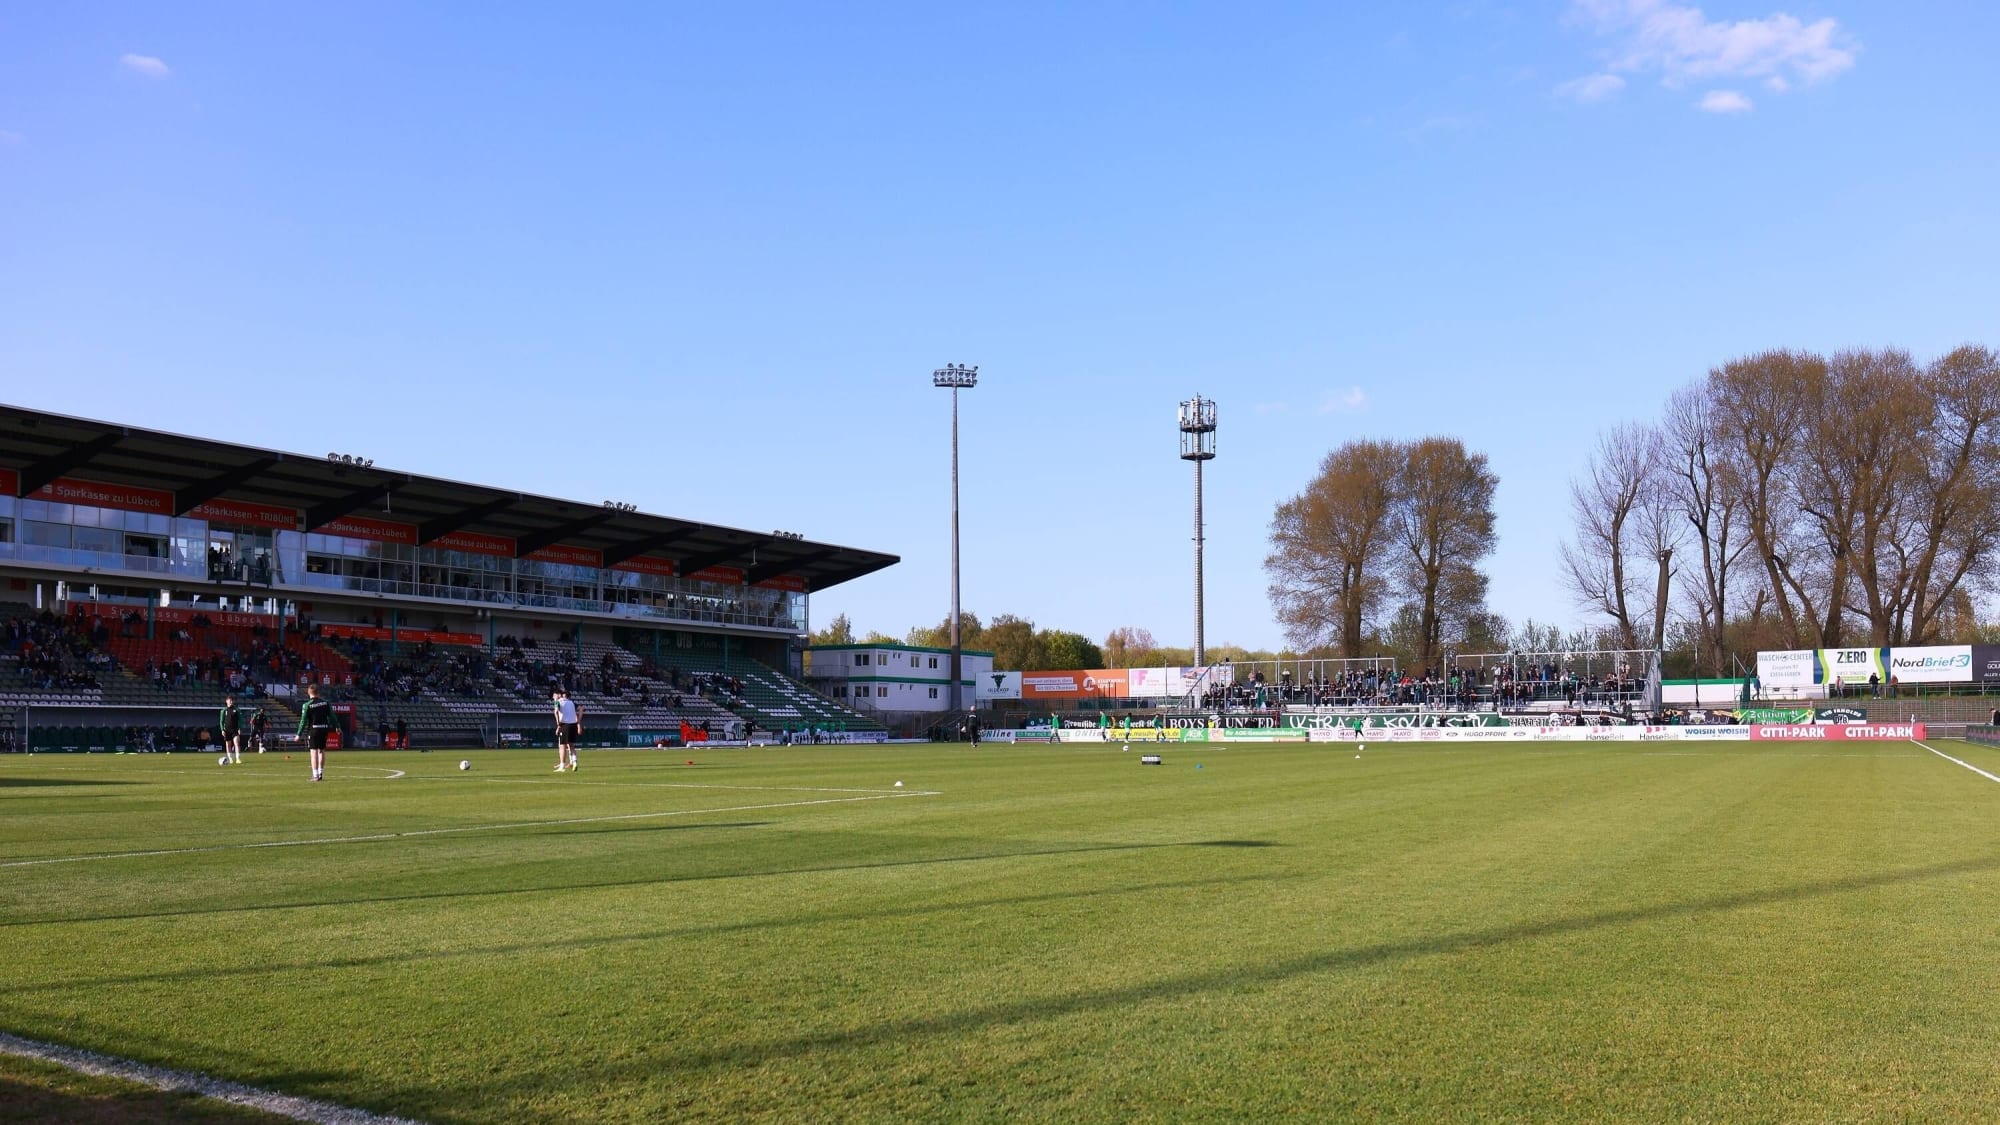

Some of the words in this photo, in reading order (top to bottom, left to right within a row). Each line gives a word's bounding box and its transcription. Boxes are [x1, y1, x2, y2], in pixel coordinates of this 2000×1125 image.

[57, 486, 109, 501] Sparkasse
[113, 495, 124, 503] zu
[127, 495, 161, 508] Lübeck
[203, 505, 252, 520] Sparkassen
[260, 511, 295, 524] TRIBÜNE
[331, 521, 371, 535] Sparkasse
[382, 527, 407, 538] Lübeck
[219, 615, 262, 624] Lübeck
[1758, 654, 1780, 662] WASCH
[1790, 653, 1812, 661] CENTER
[1892, 656, 1956, 668] NordBrief
[1169, 718, 1204, 729] BOYS
[1186, 730, 1204, 738] AOK
[1717, 727, 1749, 735] WOISIN
[1759, 727, 1825, 738] CITTI-PARK
[1845, 727, 1913, 738] CITTI-PARK
